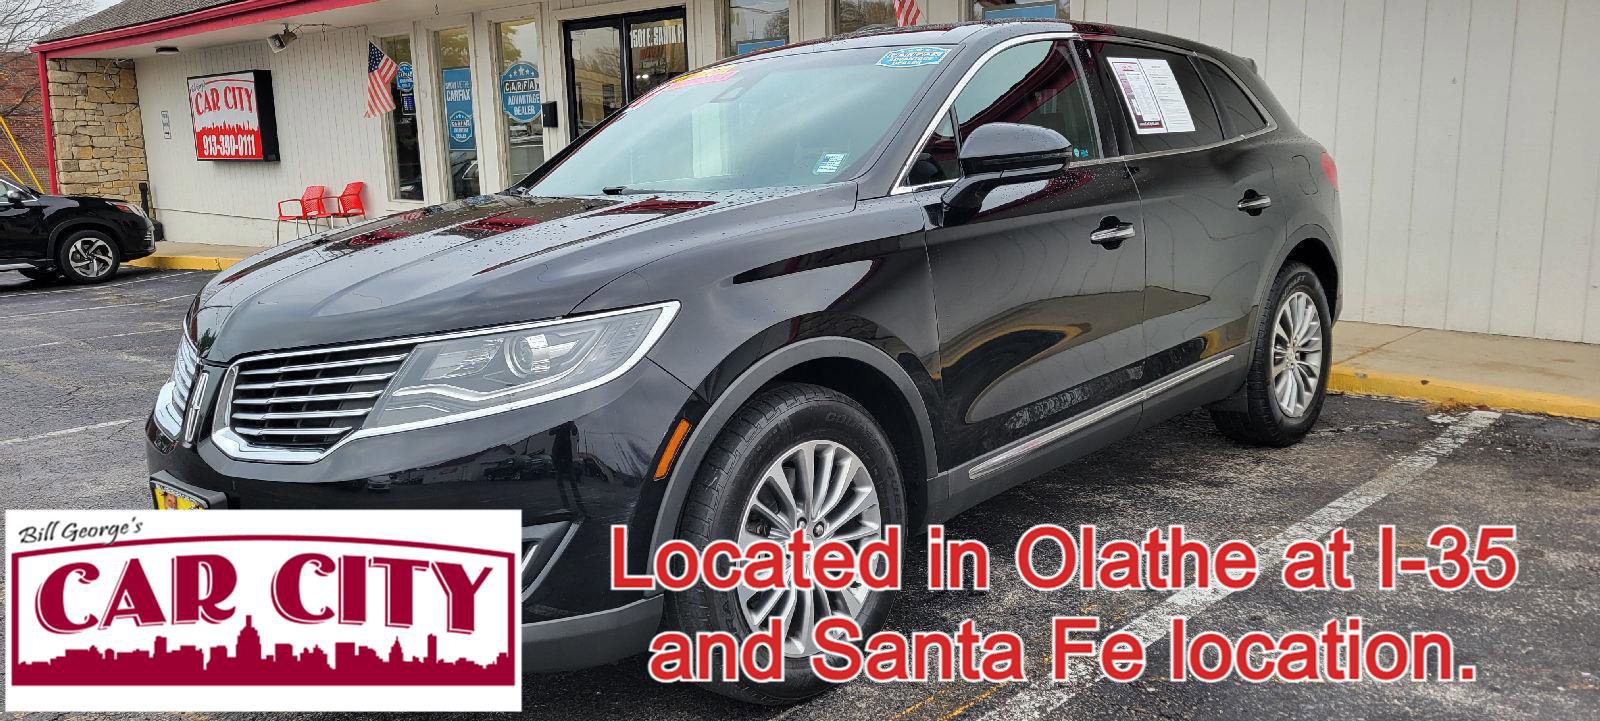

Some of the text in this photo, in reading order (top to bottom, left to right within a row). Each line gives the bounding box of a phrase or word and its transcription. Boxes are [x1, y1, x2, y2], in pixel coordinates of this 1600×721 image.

[629, 28, 646, 48] 1501
[653, 25, 677, 45] SANTA
[195, 87, 221, 115] CAR
[223, 86, 253, 113] CITY
[446, 89, 471, 101] CARFAX
[508, 93, 540, 105] ADVANTAGE
[513, 105, 536, 116] DEALER
[203, 134, 256, 156] 913-390-0111
